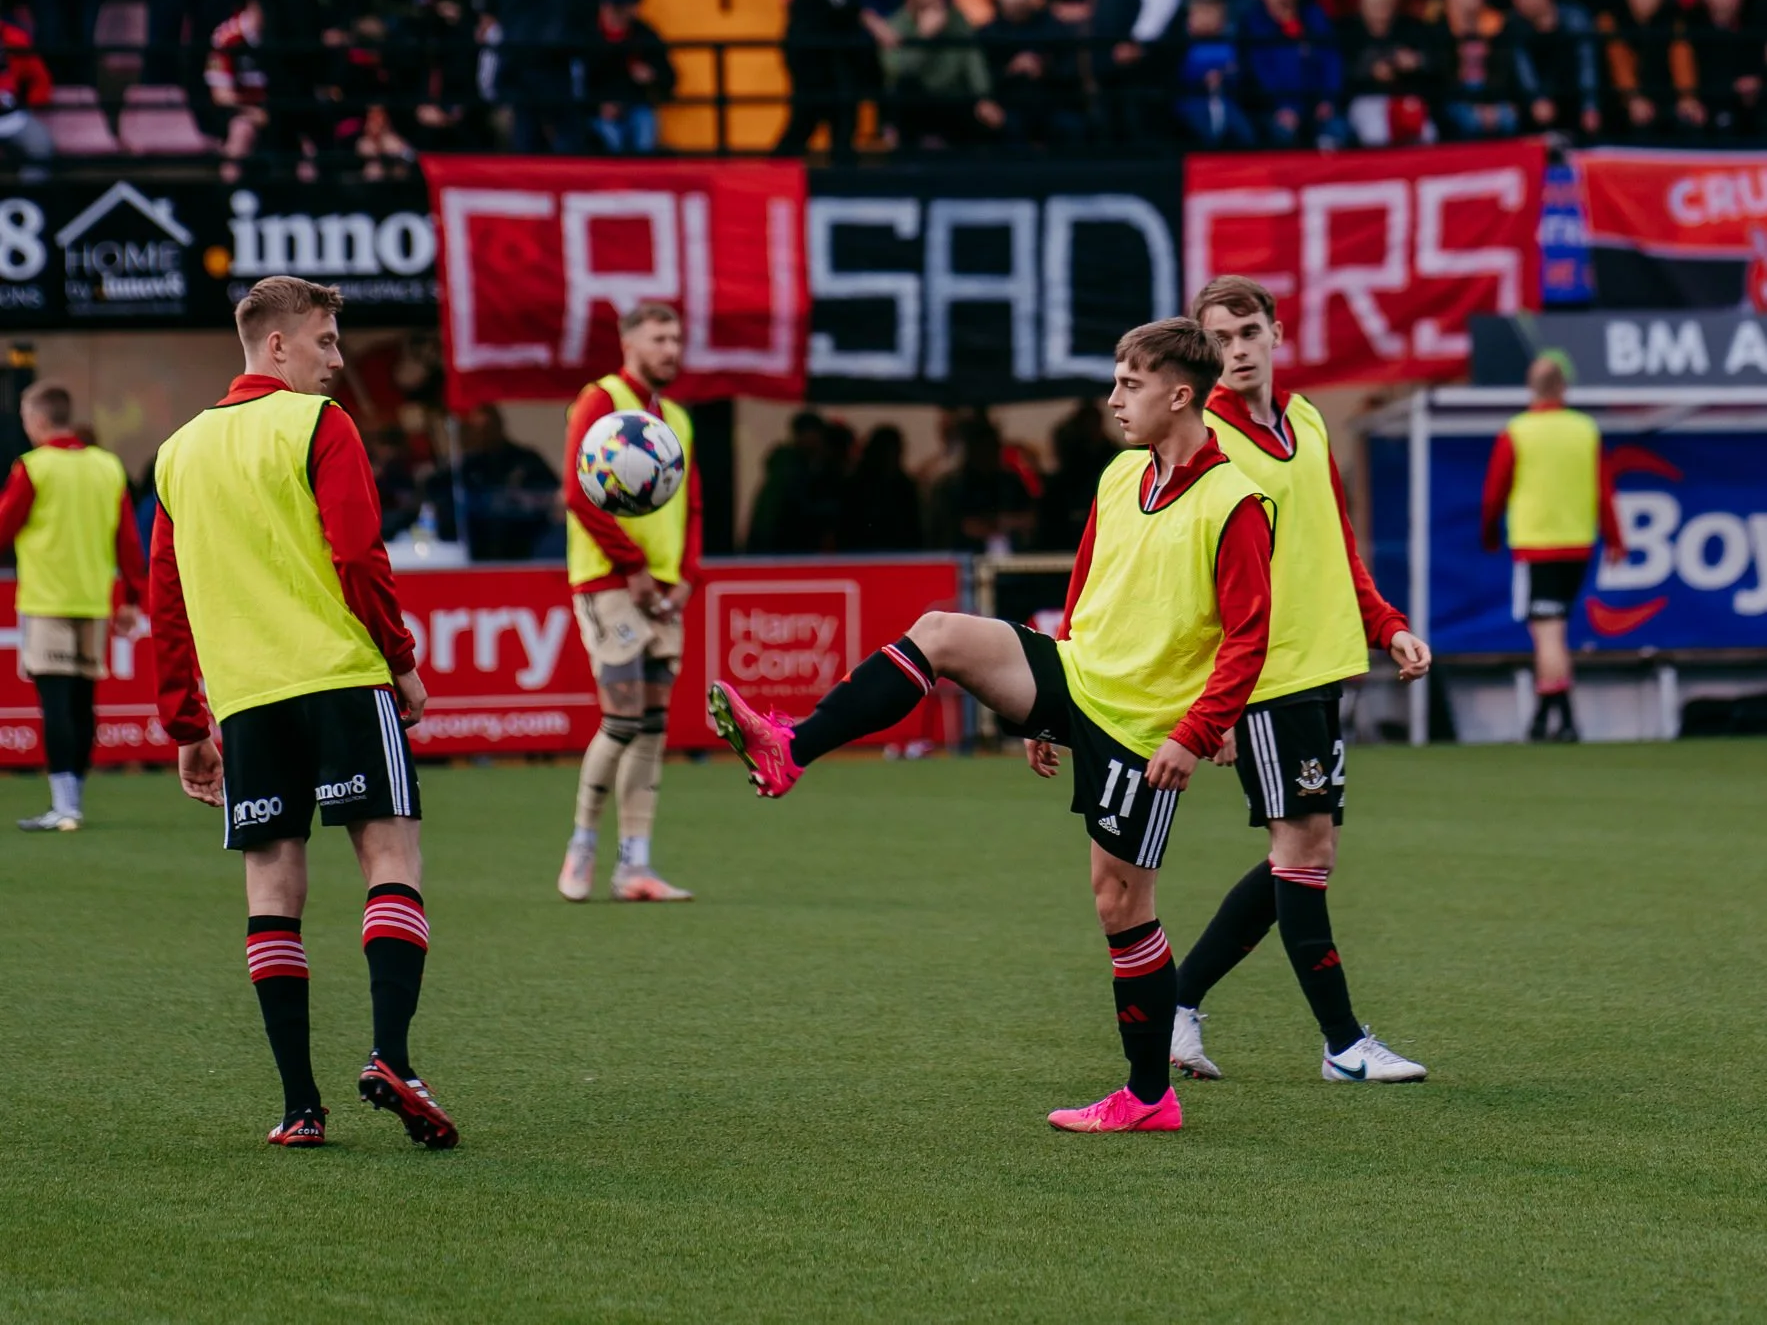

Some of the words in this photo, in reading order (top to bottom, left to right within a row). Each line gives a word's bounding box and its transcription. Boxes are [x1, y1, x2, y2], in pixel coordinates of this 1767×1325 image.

[65, 241, 181, 276] HOME
[441, 169, 1524, 380] CRUSADERS
[1605, 320, 1710, 375] BM
[730, 608, 839, 649] Harry
[728, 641, 840, 691] Corry
[1099, 758, 1142, 818] 11
[1098, 819, 1121, 836] adidas
